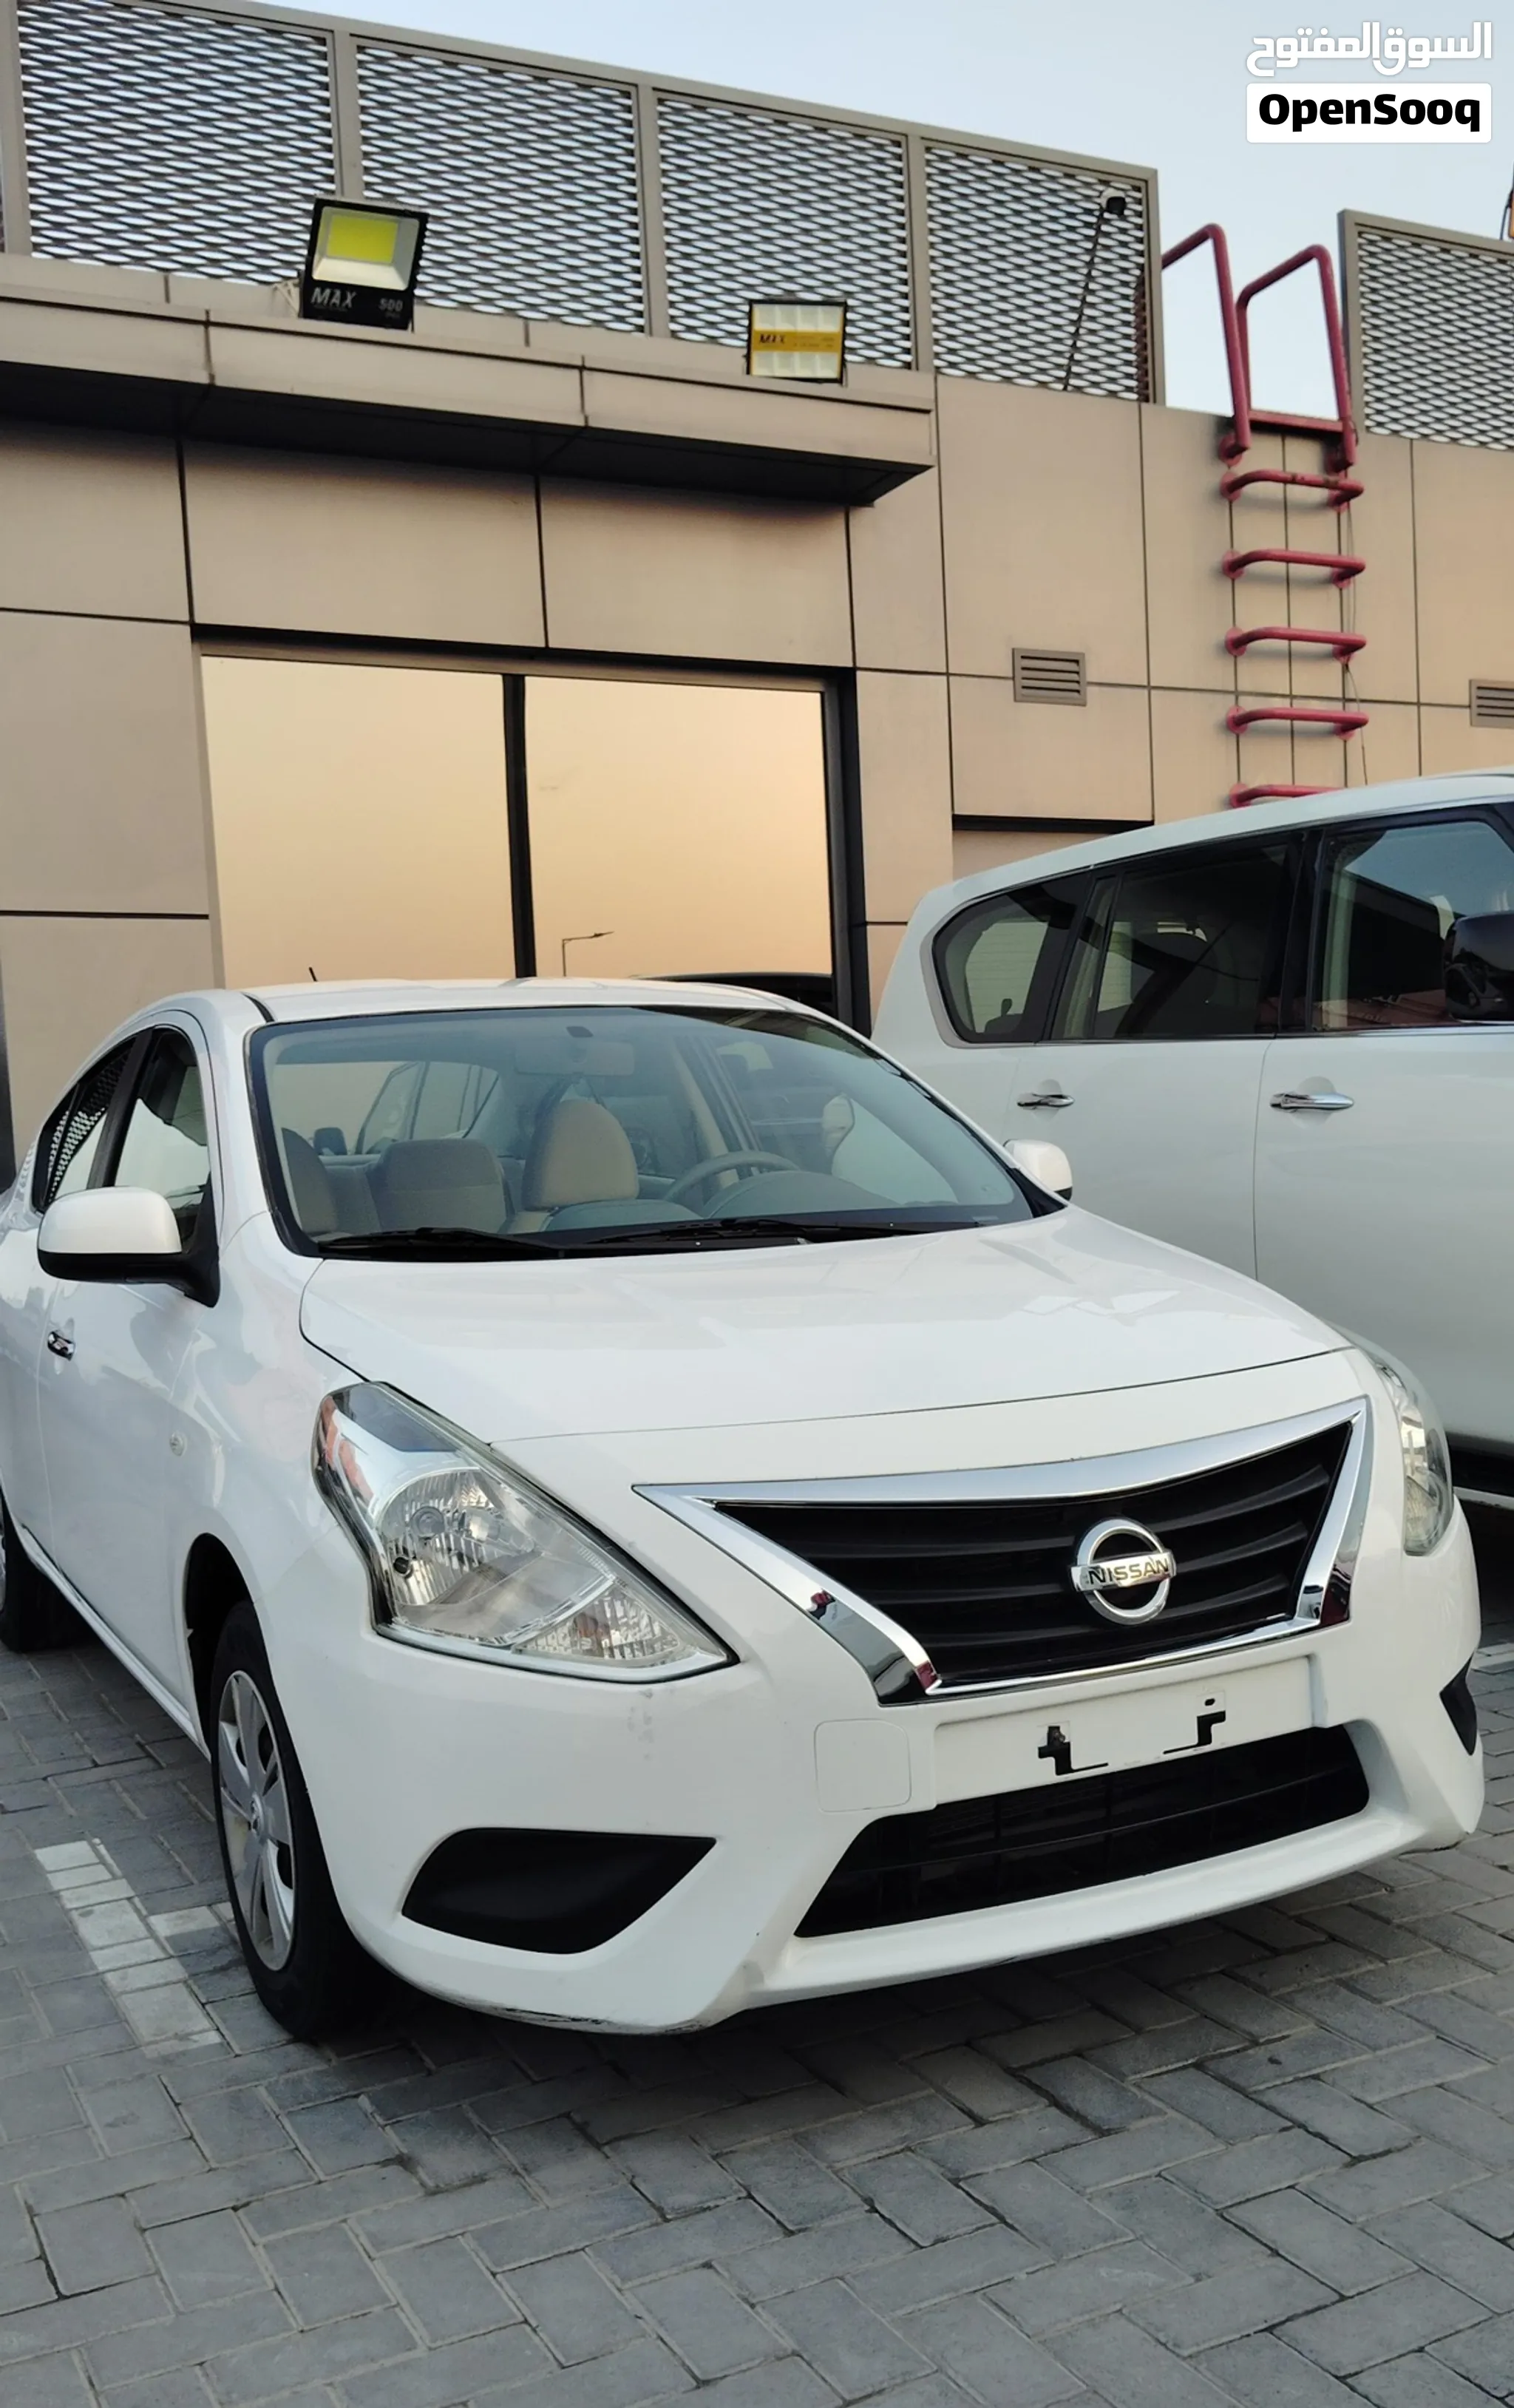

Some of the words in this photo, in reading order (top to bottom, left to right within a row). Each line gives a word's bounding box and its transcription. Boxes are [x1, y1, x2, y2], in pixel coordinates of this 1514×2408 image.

[310, 286, 357, 308] MAX
[378, 297, 404, 312] 500
[1088, 1558, 1169, 1584] NISSAN
